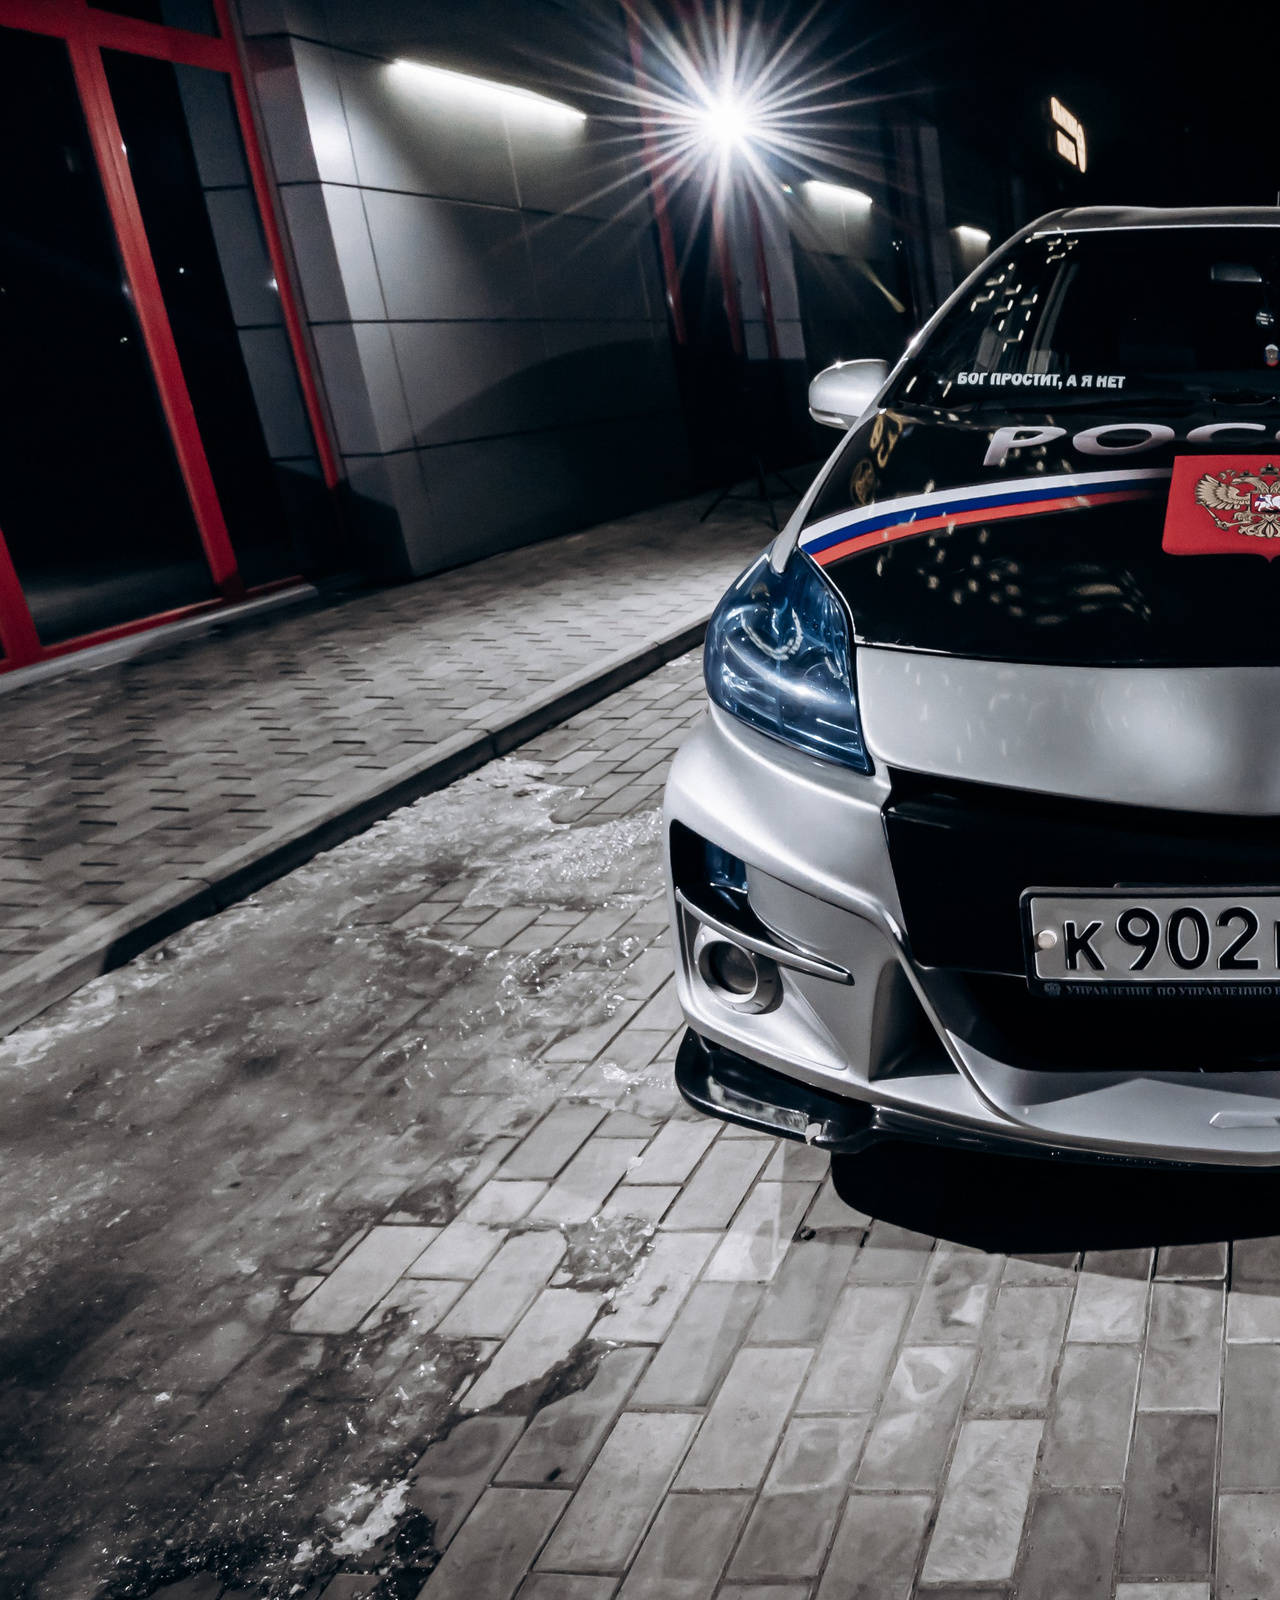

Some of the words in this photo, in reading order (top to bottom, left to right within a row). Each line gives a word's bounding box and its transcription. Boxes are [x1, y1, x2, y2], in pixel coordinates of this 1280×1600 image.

[957, 372, 988, 386] БОГ
[990, 372, 1063, 390] ПРОСТИТ,
[1066, 374, 1078, 387] А
[1081, 375, 1093, 388] Я
[1096, 375, 1126, 389] НЕТ
[1065, 985, 1154, 997] УПРАВЛЕНИЕ
[1156, 986, 1176, 996] ПО
[1179, 986, 1273, 996] УПРАВЛЕНИЮ
